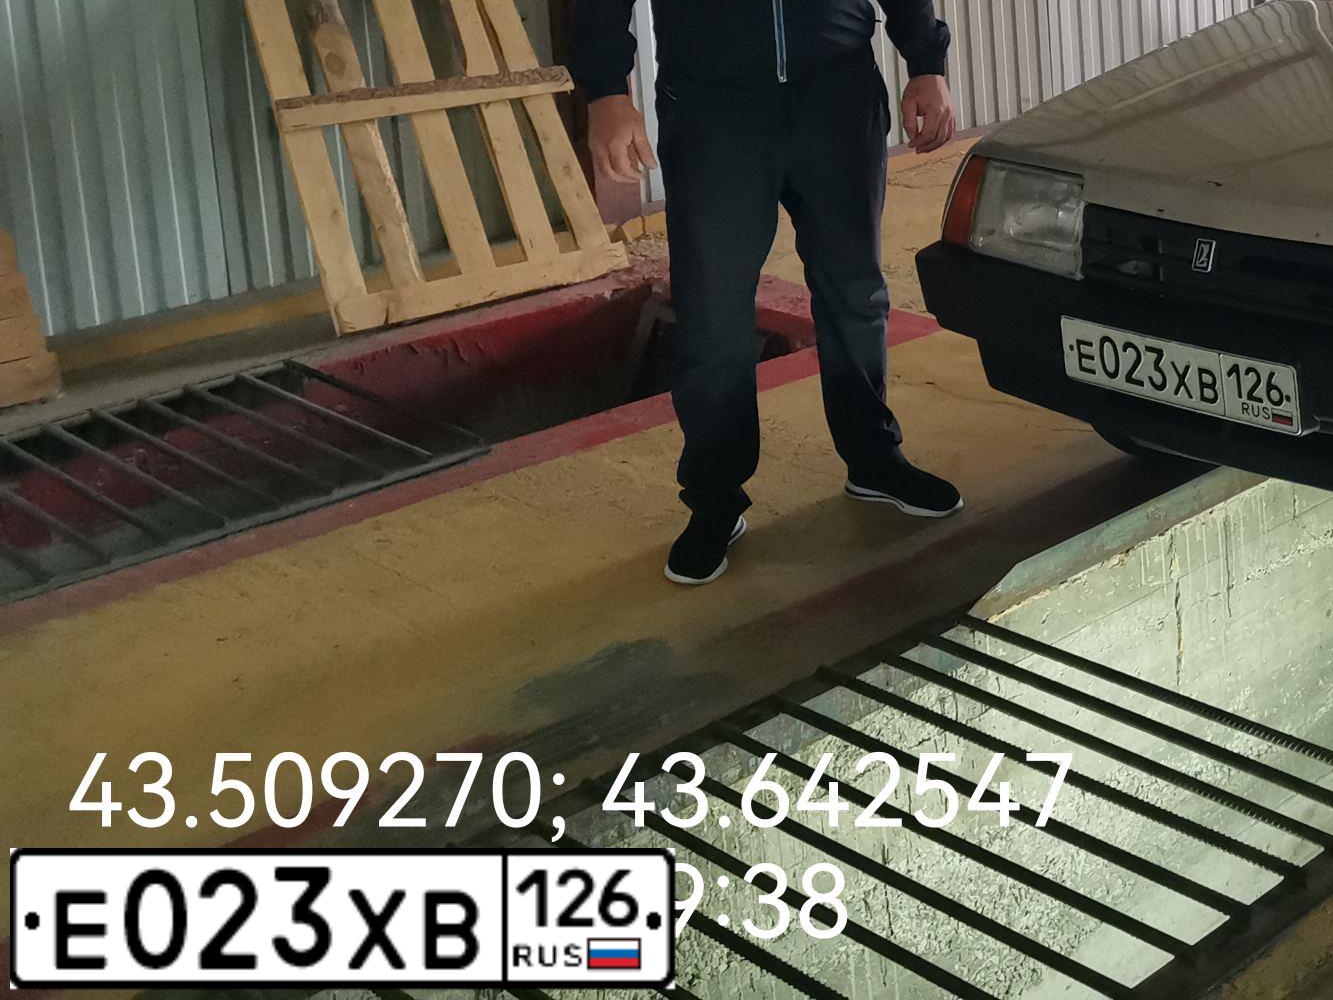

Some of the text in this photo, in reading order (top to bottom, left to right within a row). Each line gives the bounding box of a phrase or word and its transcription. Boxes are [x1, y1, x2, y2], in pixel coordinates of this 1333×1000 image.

[1075, 335, 1285, 407] E023XB 126
[1241, 401, 1271, 420] RUS
